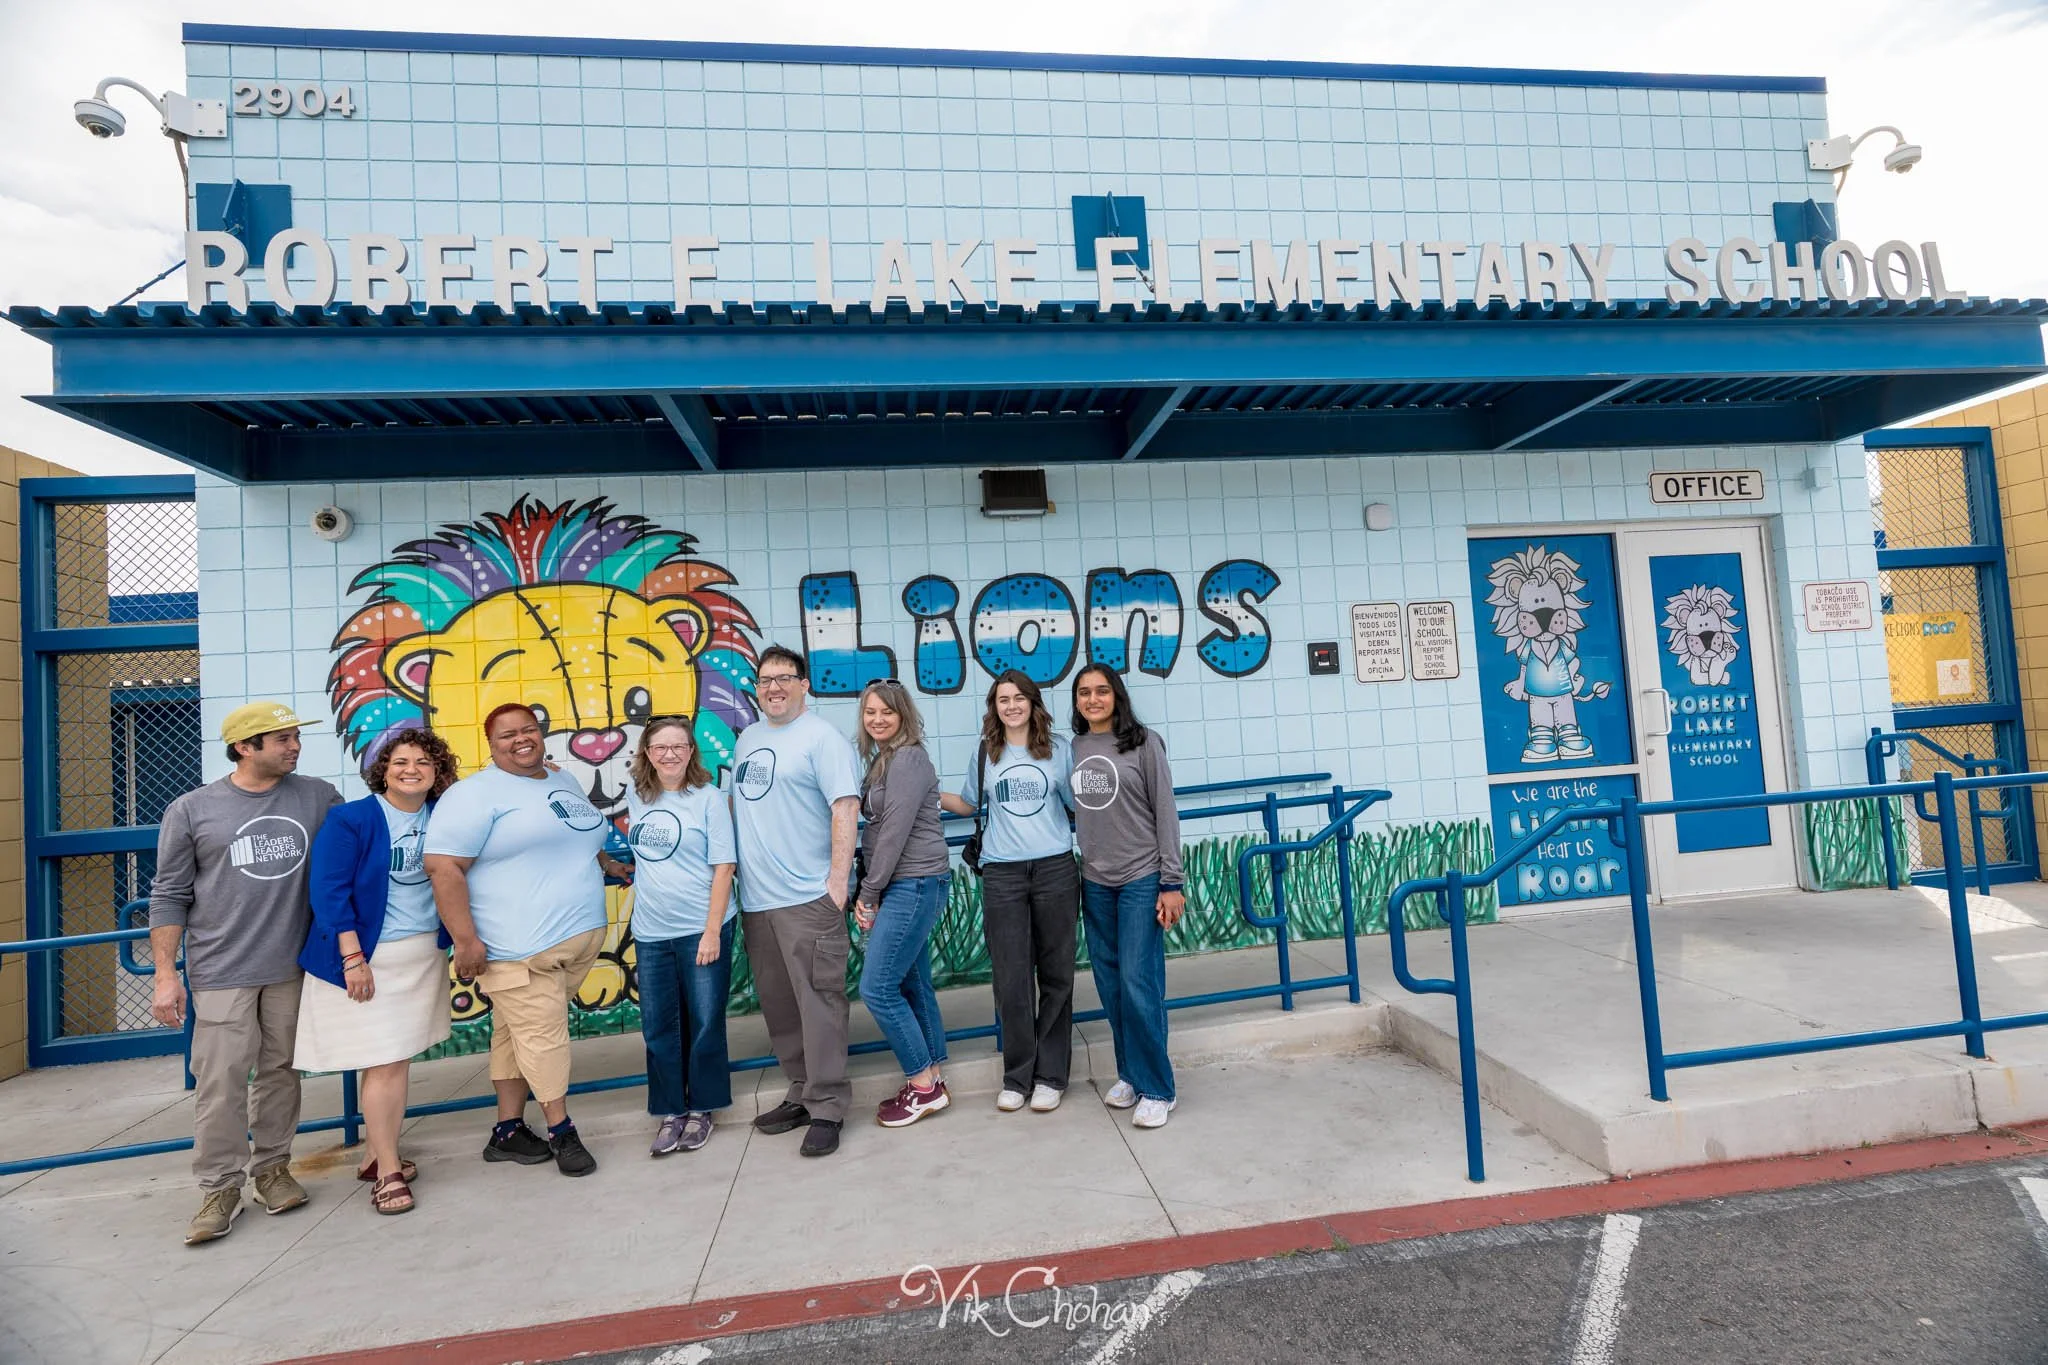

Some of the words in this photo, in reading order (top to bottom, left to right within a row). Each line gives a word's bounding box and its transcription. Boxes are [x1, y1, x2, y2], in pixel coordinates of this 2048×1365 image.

[233, 82, 357, 118] 2904
[185, 228, 614, 315] ROBERT
[813, 239, 1041, 312] LAKE
[1095, 237, 1616, 312] ELEMENTARY
[1665, 237, 1967, 306] SCHOOL
[1664, 476, 1752, 498] OFFICE
[1816, 588, 1842, 596] TOBACCO
[1825, 595, 1859, 603] PROHIBITED
[1413, 605, 1449, 616] WELCOME
[1821, 603, 1841, 611] SCHOOL
[1843, 602, 1865, 610] DISTRICT
[1354, 612, 1399, 620] BIENVENIDOS
[1358, 621, 1380, 629] TODOS
[1383, 620, 1397, 628] LOS
[1417, 617, 1427, 627] TO
[1429, 616, 1446, 626] OUR
[799, 559, 1281, 697] Lions
[1923, 621, 1957, 637] Roar
[1359, 630, 1397, 638] VISITANTES
[1367, 639, 1390, 647] DEBEN
[1427, 638, 1453, 646] VISITORS
[1358, 647, 1401, 656] REPORTARSE
[1422, 646, 1445, 654] REPORT
[1380, 657, 1389, 665] LA
[1423, 661, 1447, 669] SCHOOL
[1367, 666, 1394, 674] OFICINA
[1669, 693, 1750, 715] ROBERT
[1685, 715, 1736, 737] LAKE
[1671, 738, 1752, 754] ELEMENTARY
[1689, 753, 1738, 766] SCHOOL
[1083, 780, 1109, 788] READERS
[1010, 788, 1039, 796] READERS
[1512, 787, 1539, 803] We
[1546, 785, 1570, 800] are
[1573, 781, 1597, 798] the
[642, 827, 671, 835] LEADERS
[254, 835, 294, 848] LEADERS
[640, 833, 669, 842] READERS
[640, 840, 673, 848] NETWORK
[255, 843, 296, 856] READERS
[1537, 841, 1572, 860] Hear
[255, 849, 303, 863] NETWORK
[1516, 857, 1621, 901] Roar
